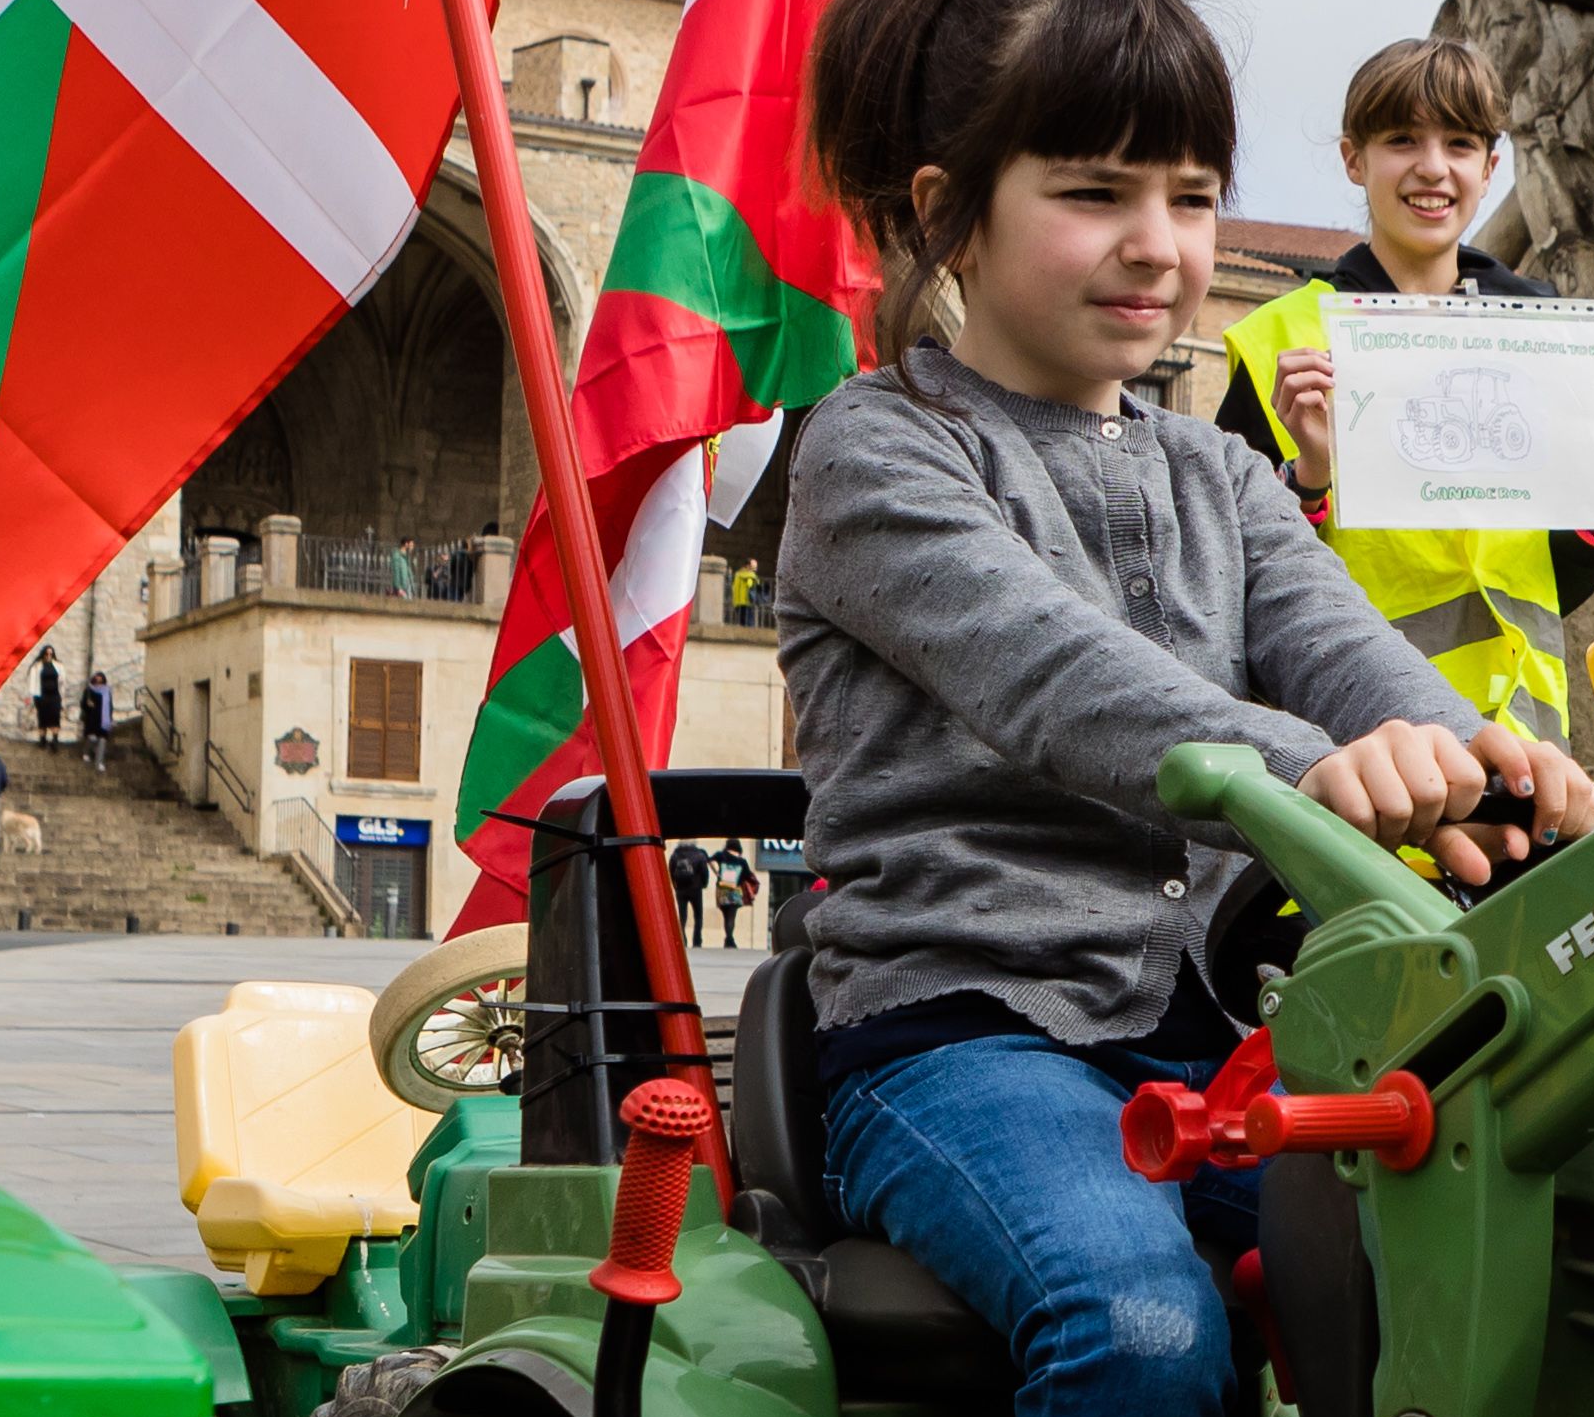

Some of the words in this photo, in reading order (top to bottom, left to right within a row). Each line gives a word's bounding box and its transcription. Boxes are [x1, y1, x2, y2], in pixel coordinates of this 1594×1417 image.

[1339, 320, 1410, 352] TODOS
[1411, 333, 1456, 350] CON
[1462, 336, 1493, 350] LOS
[1420, 481, 1531, 502] GANADEROS
